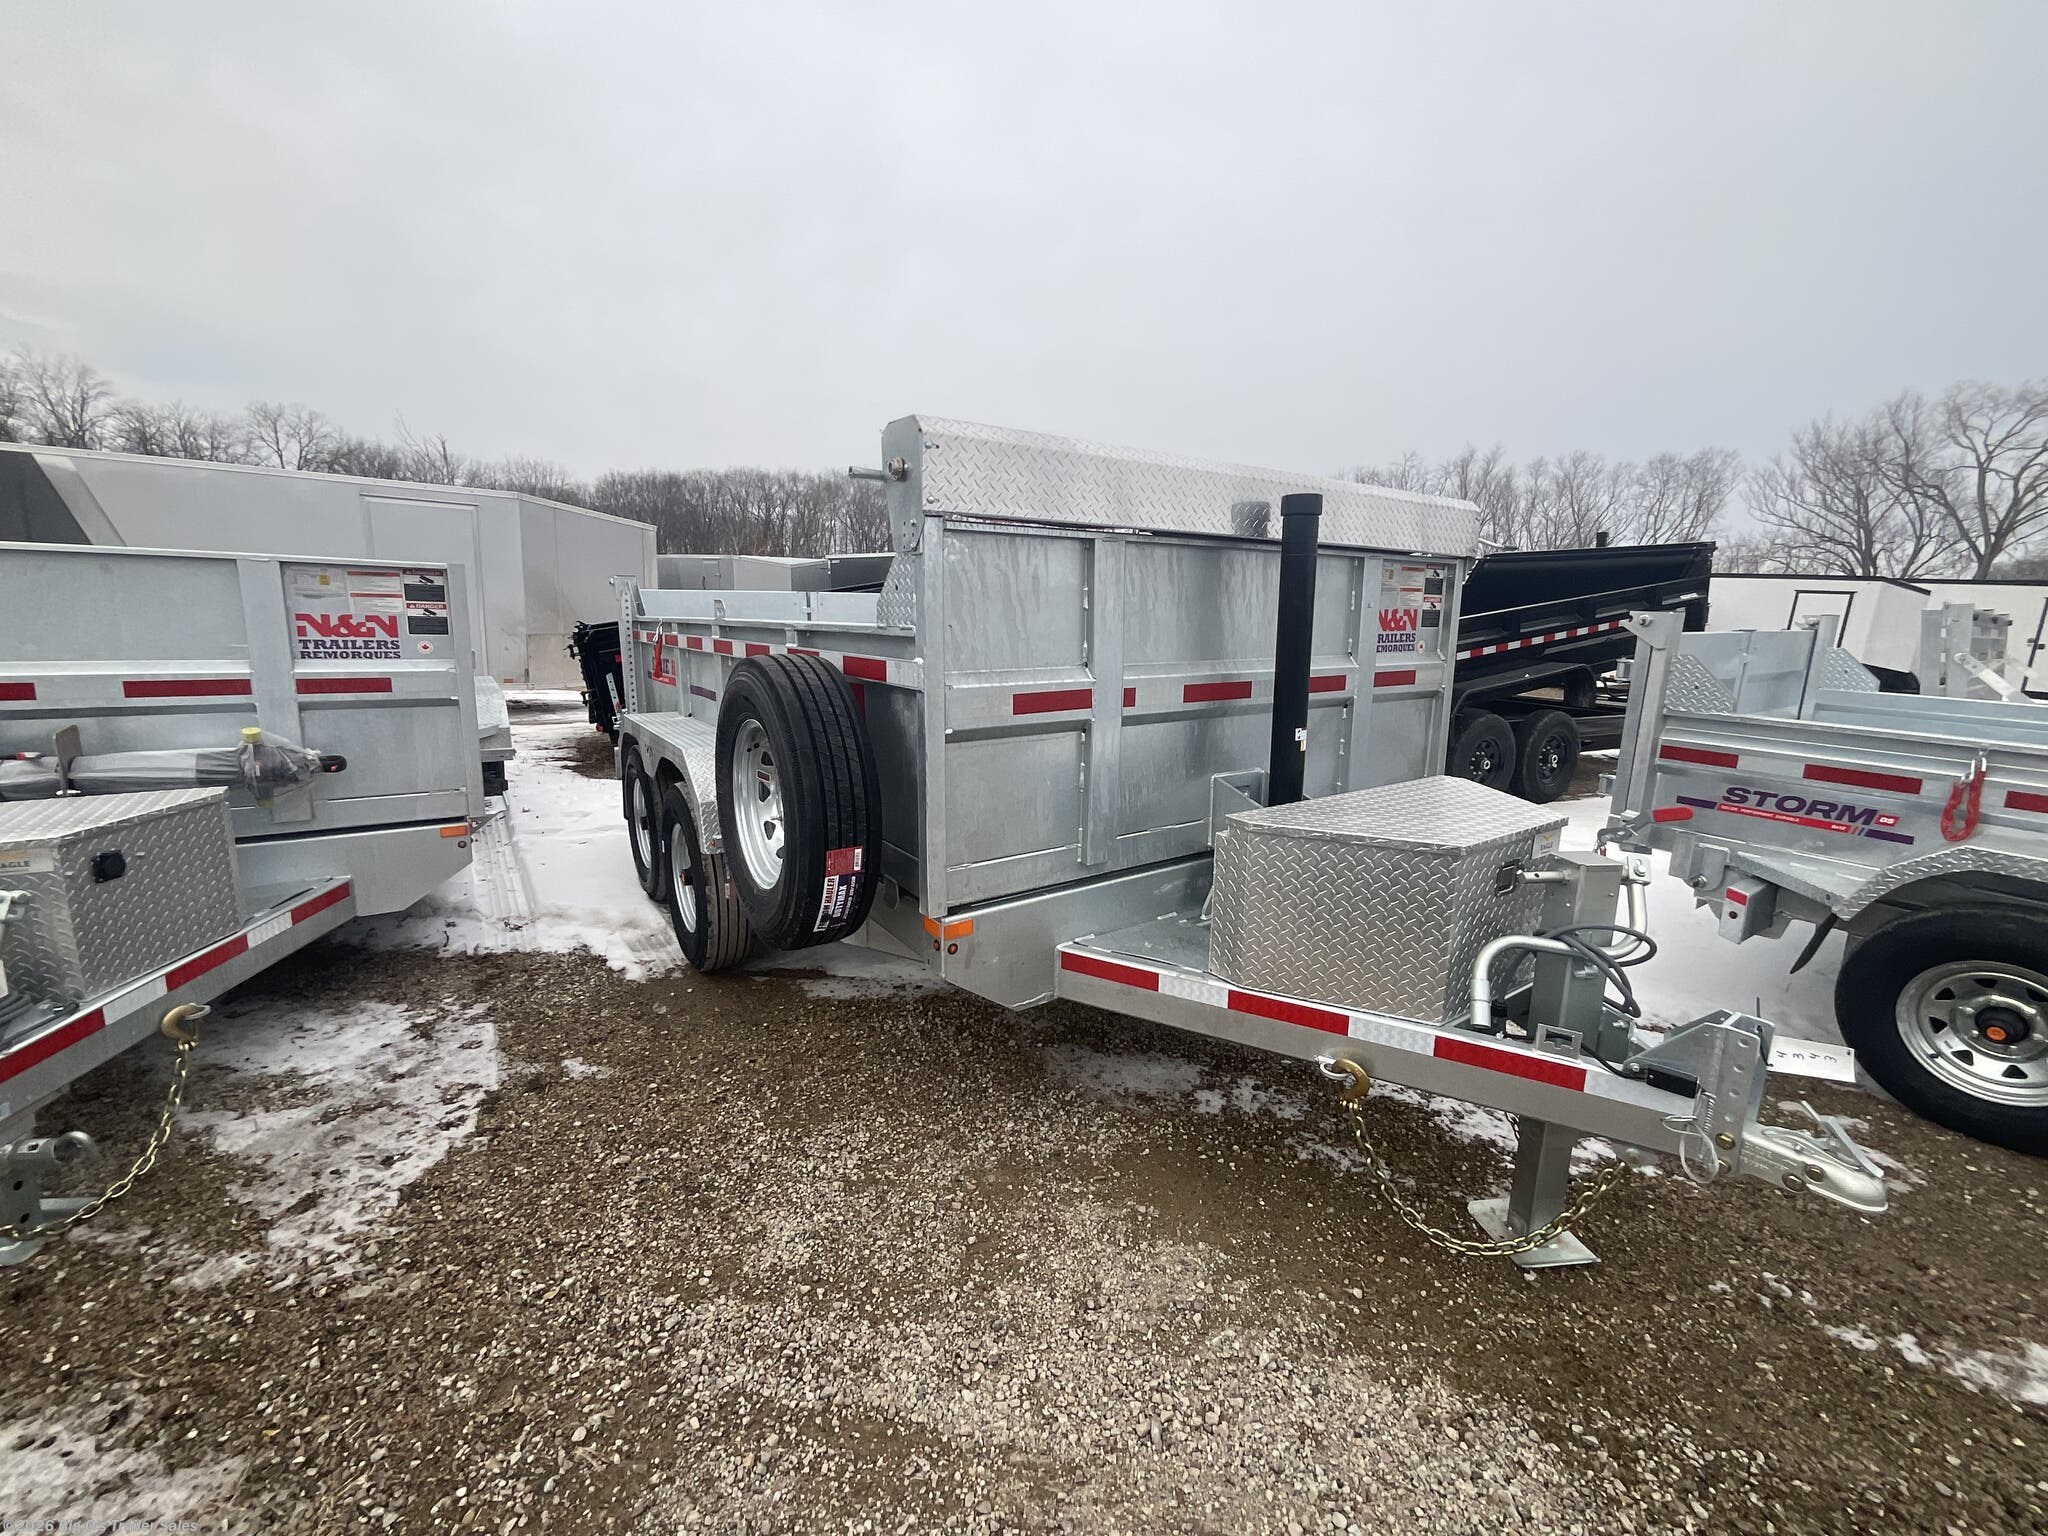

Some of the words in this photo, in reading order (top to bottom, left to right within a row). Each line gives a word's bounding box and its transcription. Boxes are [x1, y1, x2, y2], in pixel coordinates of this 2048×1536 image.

[1377, 633, 1416, 643] RAILERS
[299, 639, 400, 650] TRAILERS
[1376, 643, 1415, 653] EMORQUES
[300, 651, 401, 660] REMORQUES
[1722, 786, 1879, 826] STORM
[0, 860, 31, 868] AGLE
[824, 878, 835, 905] HAULER
